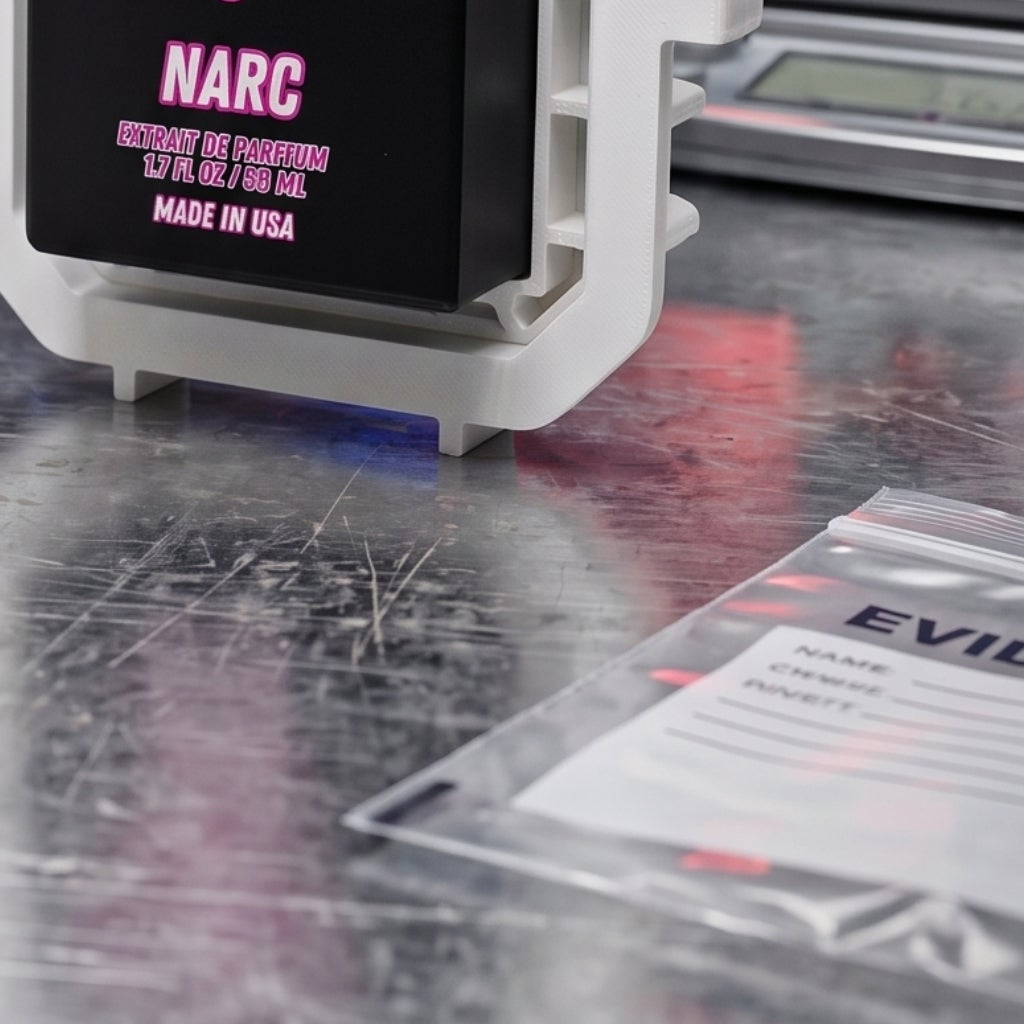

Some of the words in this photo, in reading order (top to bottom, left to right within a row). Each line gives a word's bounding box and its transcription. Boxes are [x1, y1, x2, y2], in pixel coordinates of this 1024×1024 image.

[159, 40, 305, 120] NARC
[117, 120, 200, 155] EXTRAIT
[202, 131, 231, 160] DE
[232, 135, 330, 172] PARFFUM
[143, 154, 171, 180] 1.7
[172, 156, 194, 183] FL
[199, 160, 226, 188] OZ
[228, 164, 241, 189] /
[275, 170, 307, 198] ML
[152, 194, 216, 230] MADE
[219, 204, 247, 234] IN
[251, 209, 294, 241] USA
[794, 644, 892, 675] NAME
